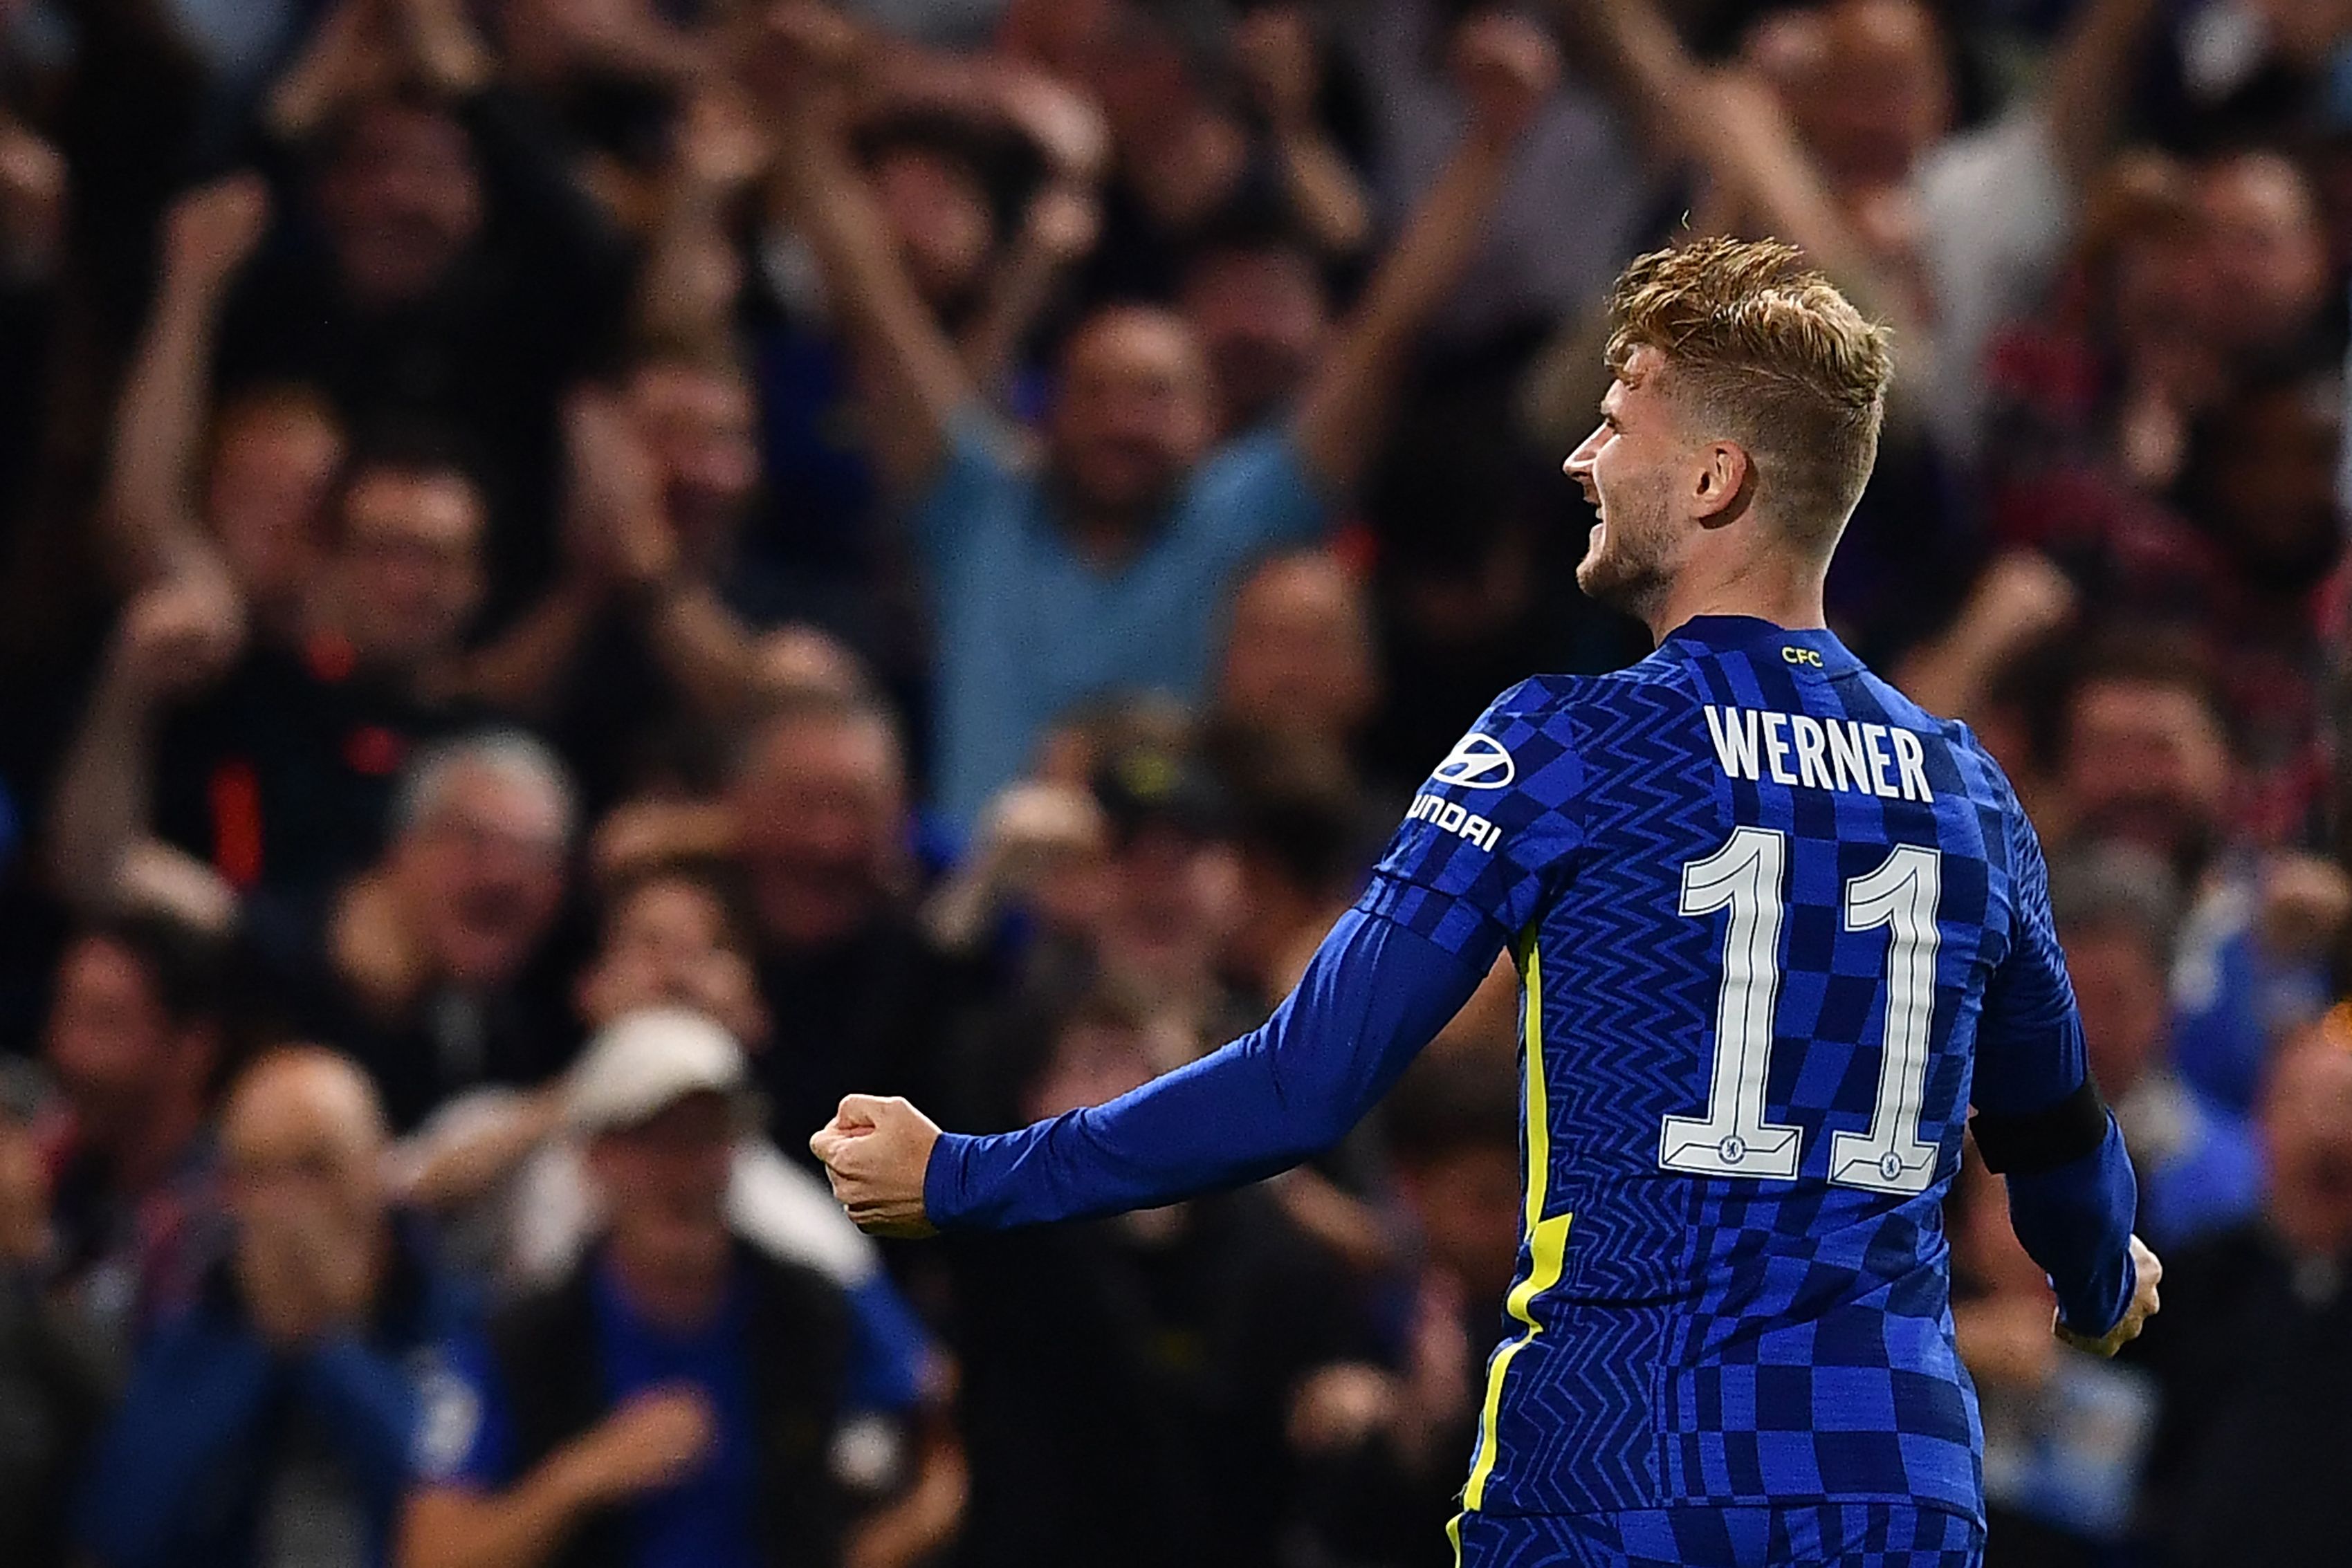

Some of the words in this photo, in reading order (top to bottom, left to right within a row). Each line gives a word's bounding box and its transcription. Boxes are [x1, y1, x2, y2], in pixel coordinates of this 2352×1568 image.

[1782, 646, 1823, 667] CFC
[1703, 705, 1935, 803] WERNER
[1658, 825, 1941, 1196] 11
